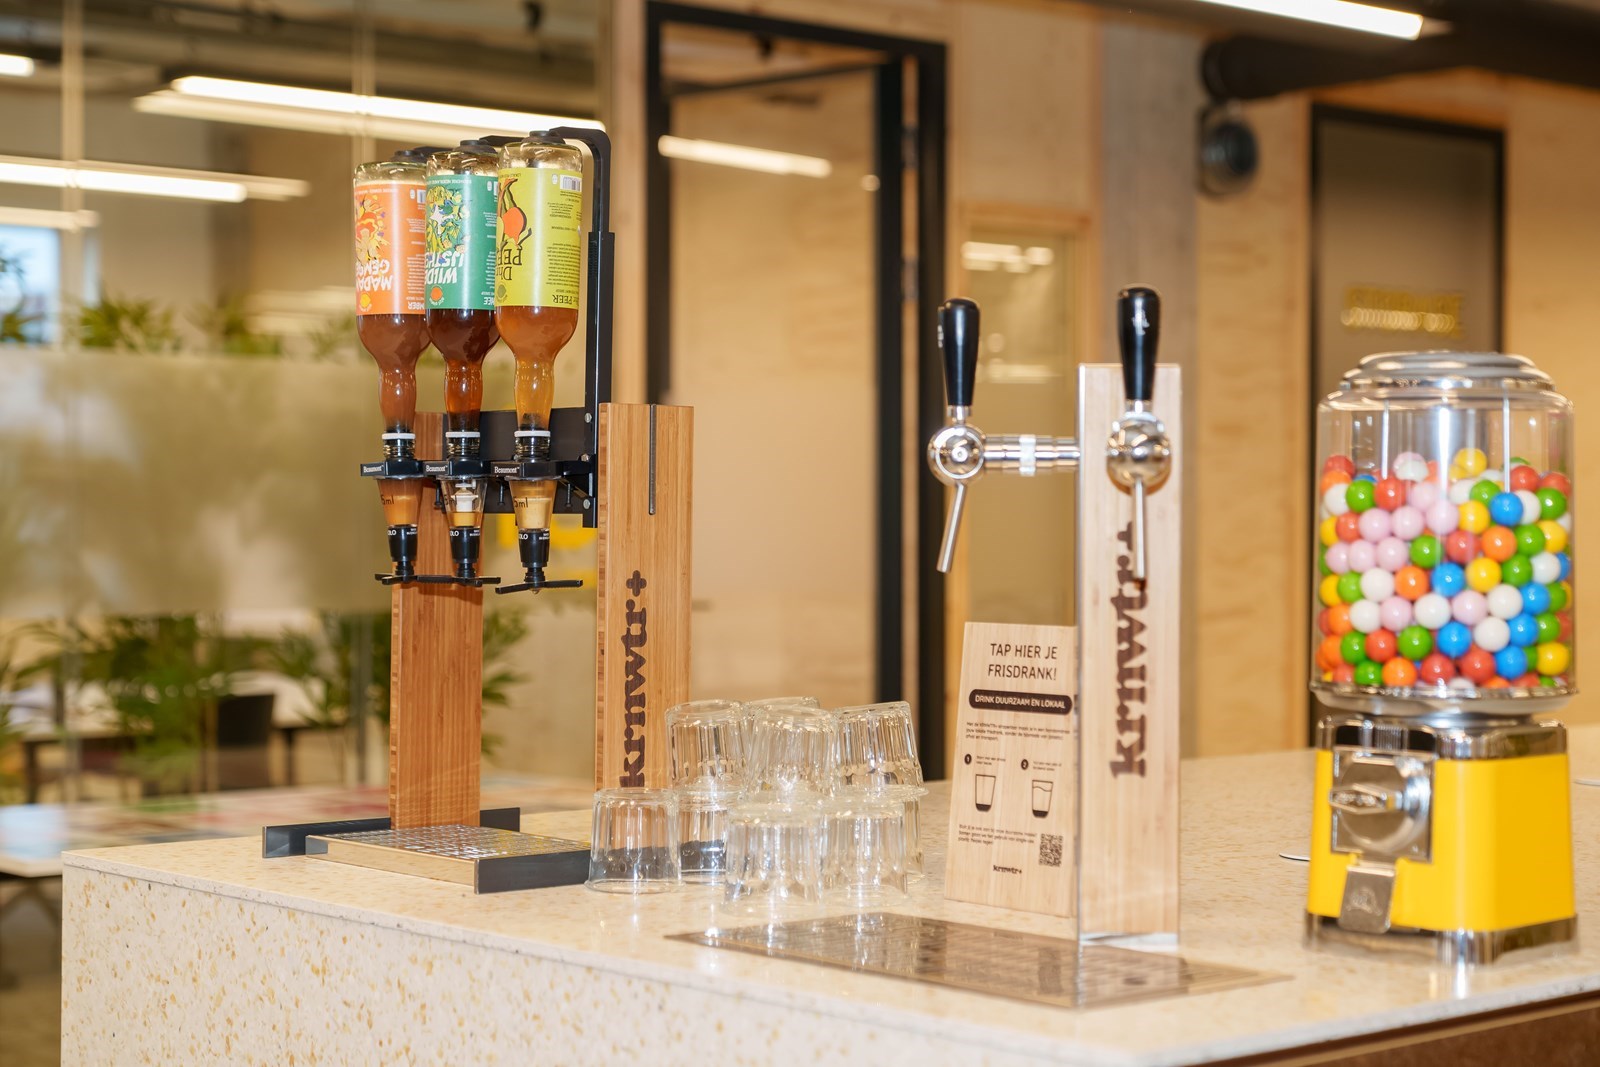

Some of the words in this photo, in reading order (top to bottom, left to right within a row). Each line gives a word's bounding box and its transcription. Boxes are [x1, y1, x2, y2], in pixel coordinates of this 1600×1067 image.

[425, 250, 464, 268] IJSTH
[496, 248, 523, 266] PEE
[356, 274, 393, 292] MADA
[425, 266, 457, 285] WILD
[552, 294, 573, 305] PEER
[990, 643, 1011, 657] TAP
[1015, 644, 1041, 659] HIER
[1045, 646, 1057, 660] JE
[987, 663, 1057, 681] FRISDRANK!
[975, 695, 994, 703] DRINK
[995, 697, 1030, 706] DUURZAAM
[1031, 699, 1040, 707] EN
[1041, 701, 1066, 709] LOKAAL
